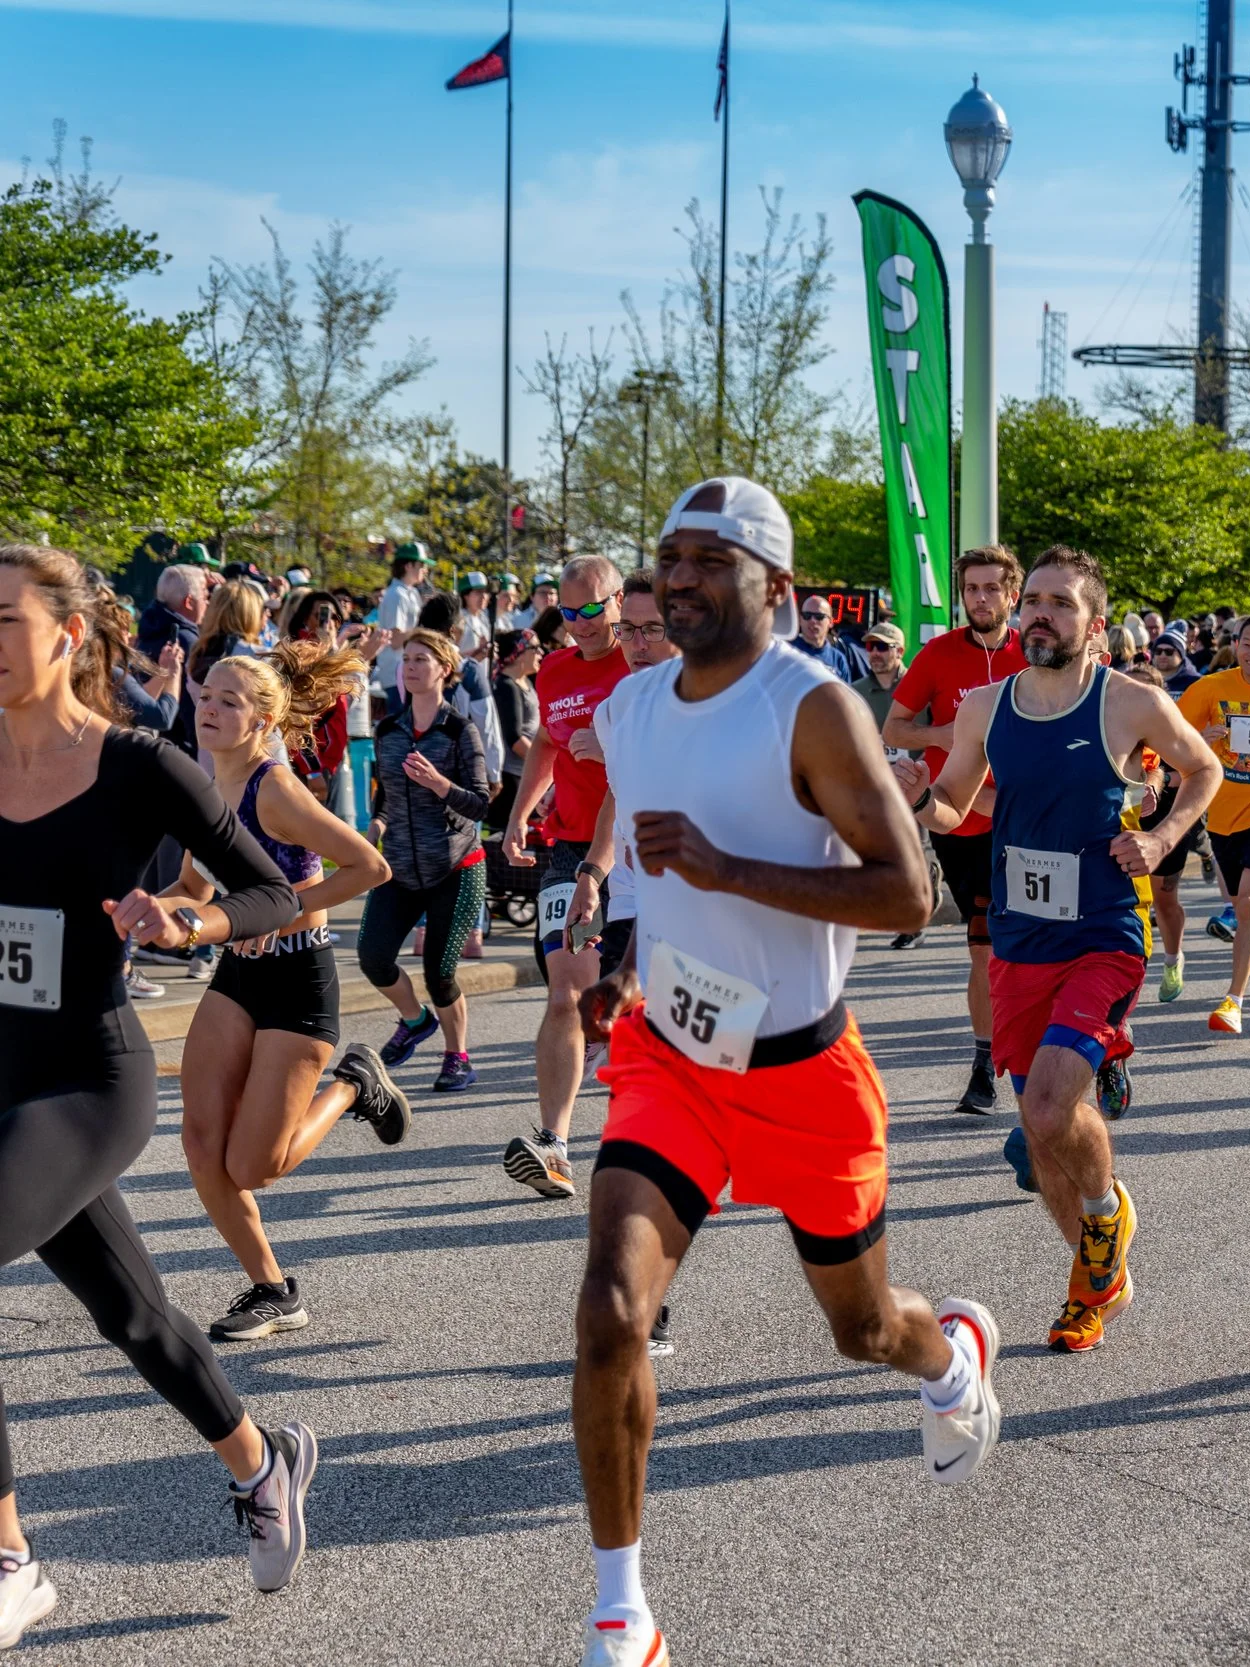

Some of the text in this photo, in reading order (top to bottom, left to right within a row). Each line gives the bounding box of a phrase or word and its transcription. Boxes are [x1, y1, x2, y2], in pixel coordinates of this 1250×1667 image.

[1236, 773, 1250, 781] Rock
[1024, 870, 1051, 904] 51
[545, 898, 567, 922] 49
[0, 920, 35, 932] RMES
[274, 923, 330, 957] NIKE
[670, 984, 721, 1045] 35
